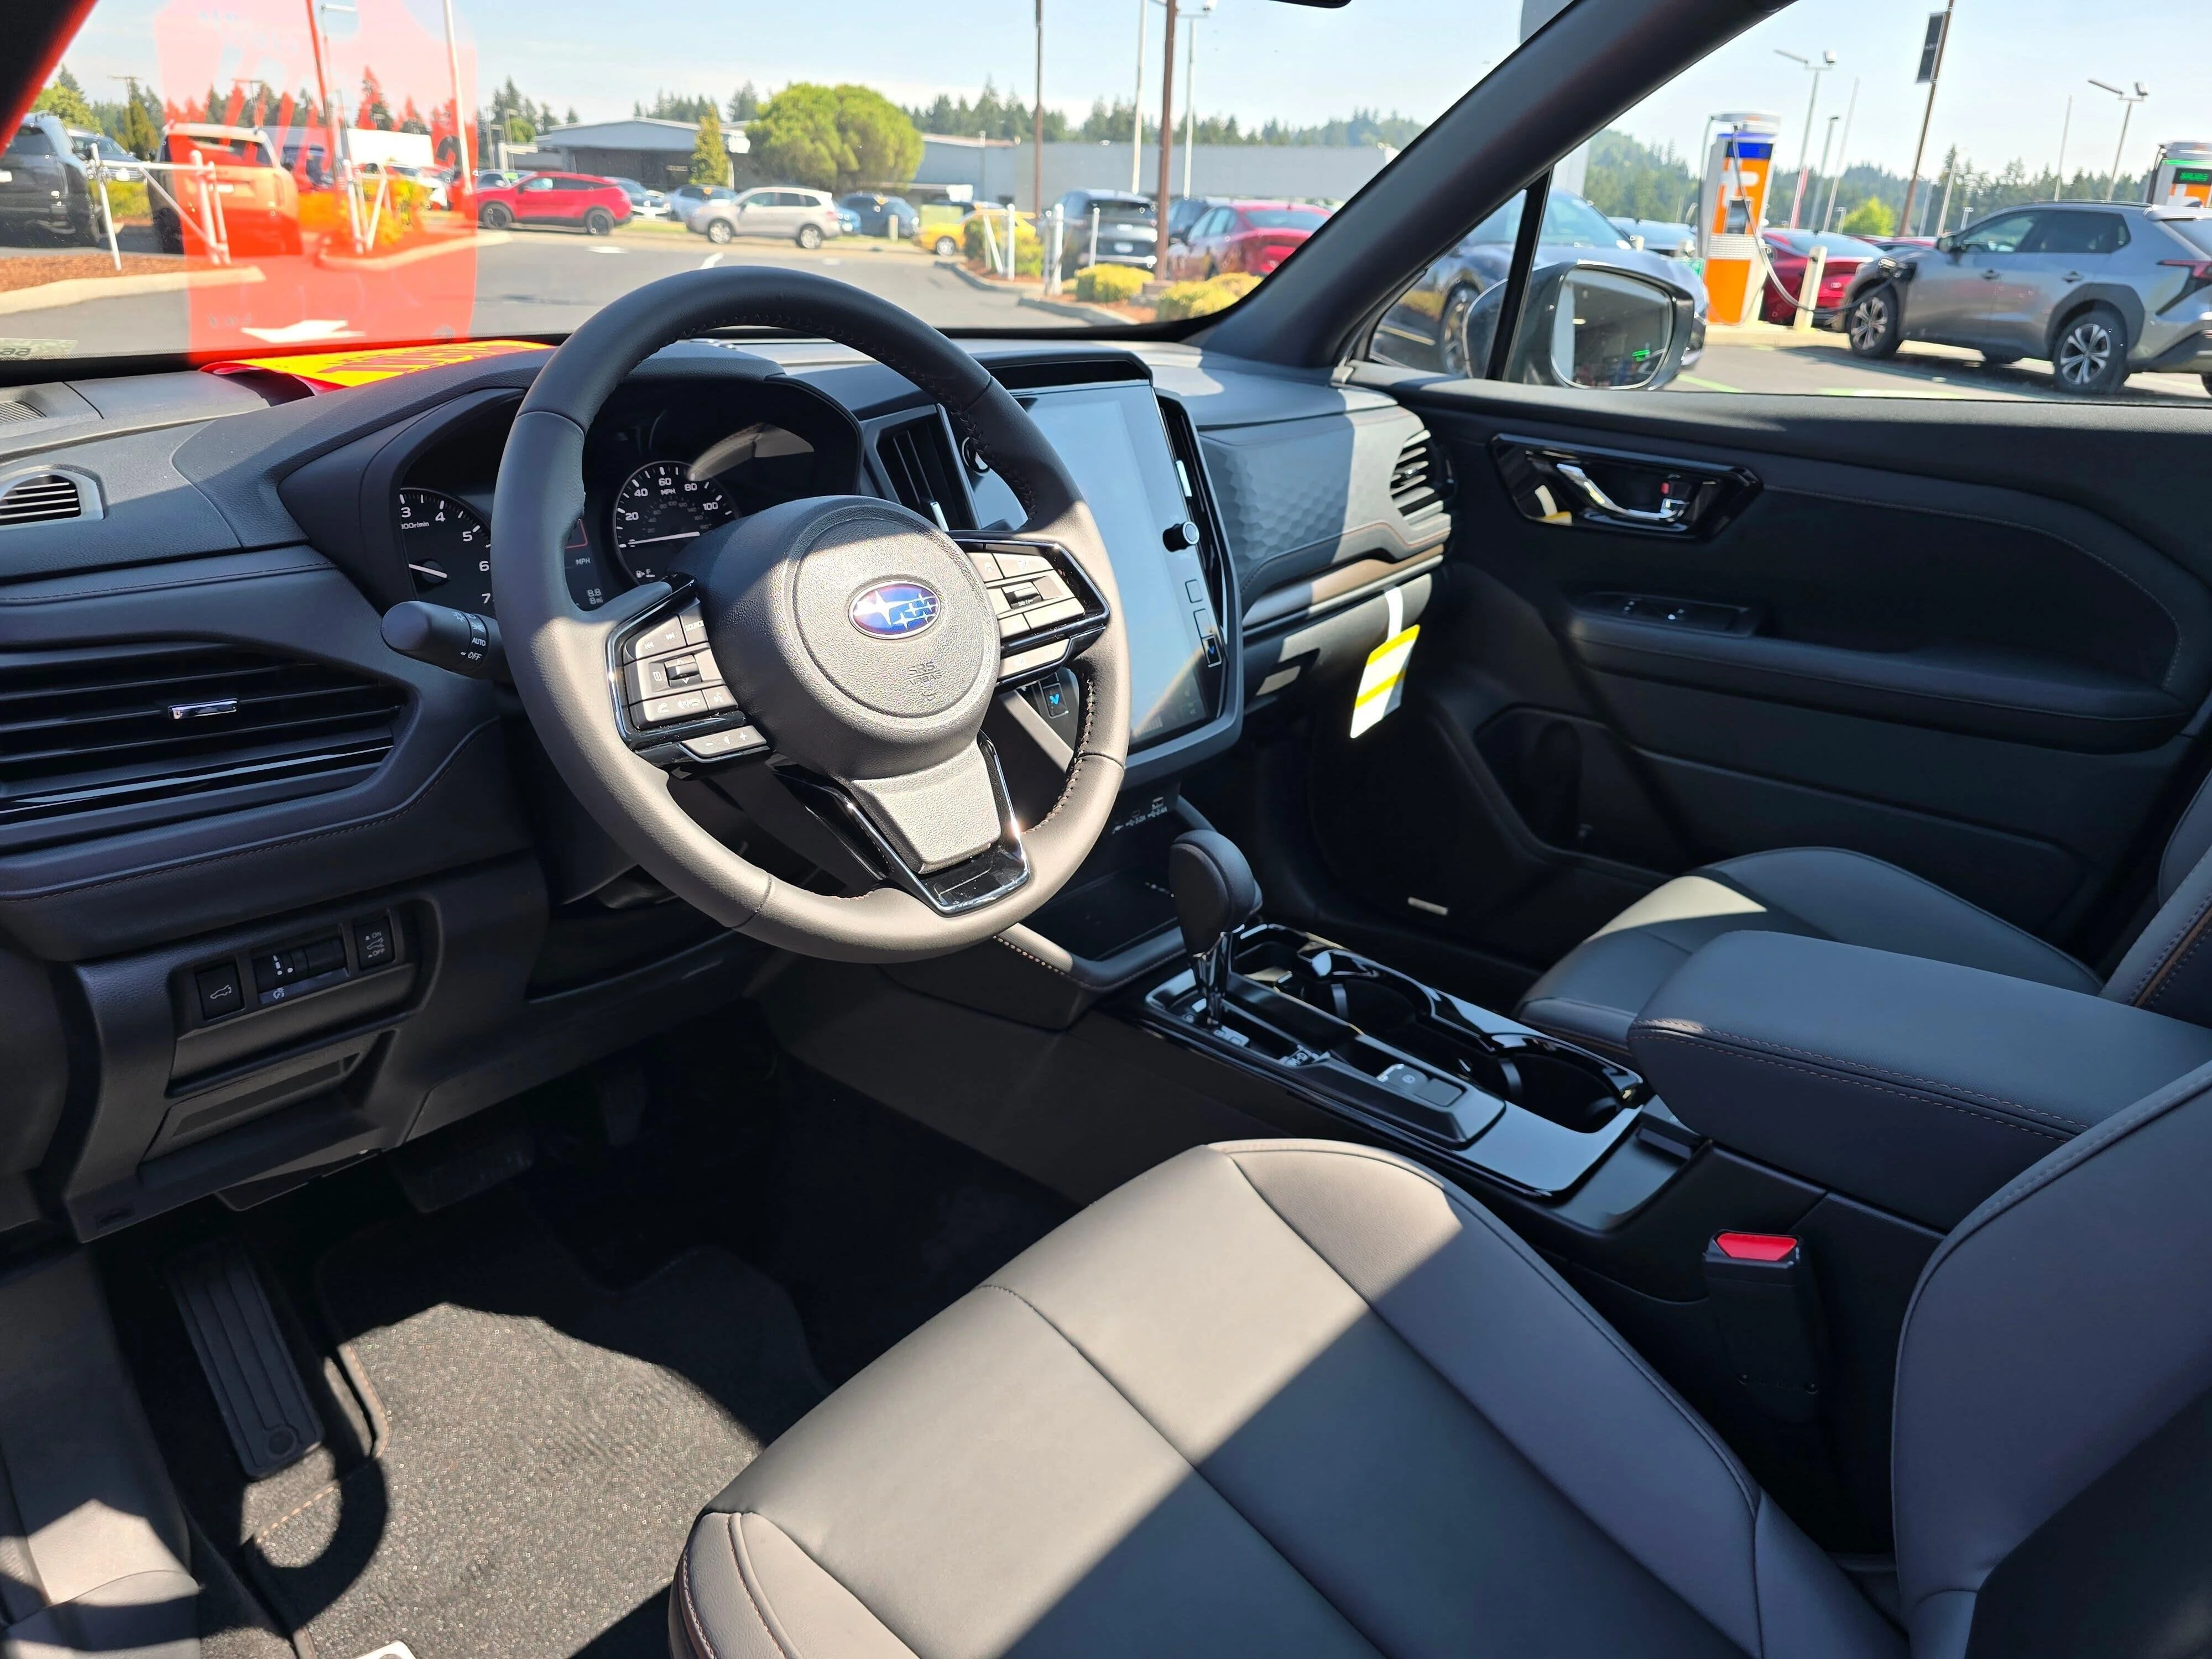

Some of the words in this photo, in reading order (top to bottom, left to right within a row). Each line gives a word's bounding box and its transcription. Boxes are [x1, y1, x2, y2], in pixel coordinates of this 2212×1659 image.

[658, 477, 672, 486] 60
[684, 483, 698, 491] 80
[634, 488, 649, 497] 40
[703, 502, 718, 510] 100
[400, 507, 411, 518] 3
[435, 512, 446, 521] 4
[625, 512, 639, 521] 20
[462, 531, 473, 542] 5
[479, 560, 489, 571] 6
[575, 557, 591, 566] MPH
[481, 593, 491, 604] 7
[685, 620, 705, 632] SOURCE
[472, 637, 486, 646] AUTO
[467, 651, 482, 661] OFF
[372, 948, 385, 956] OFF
